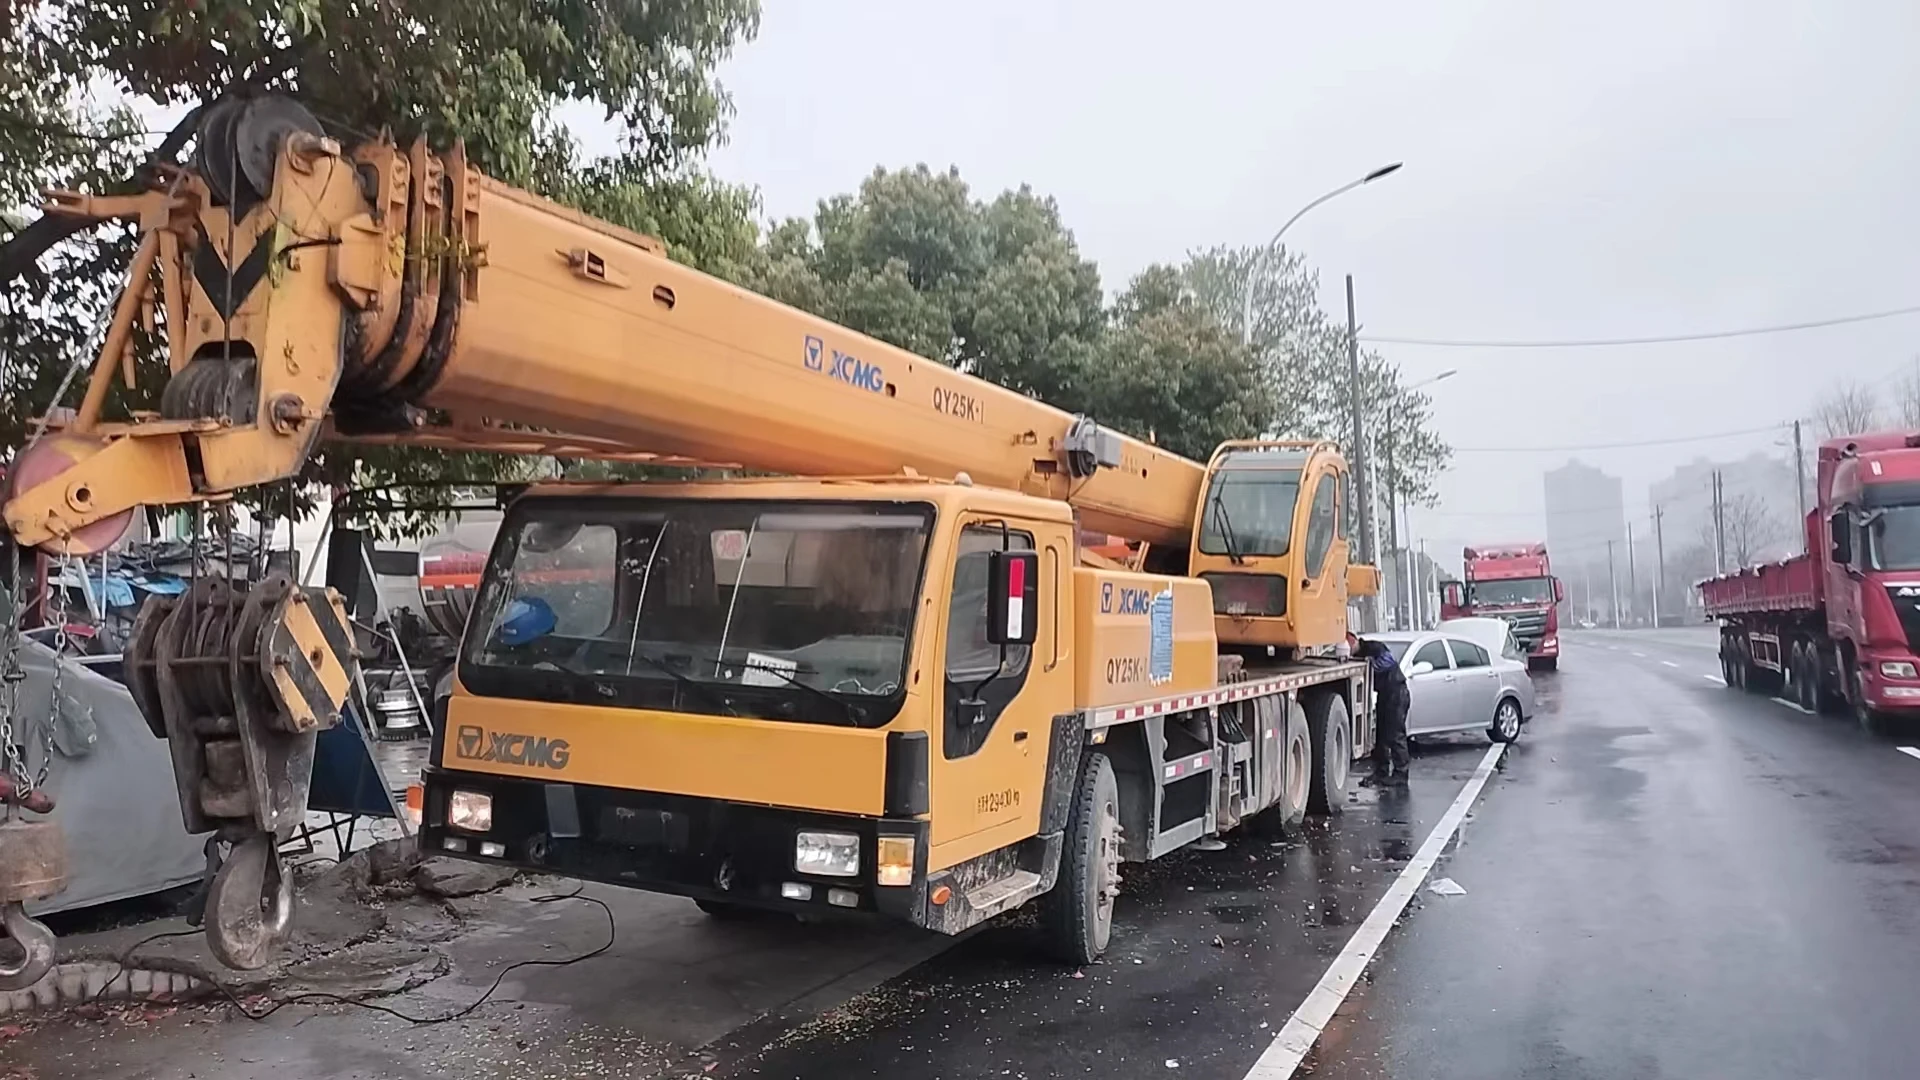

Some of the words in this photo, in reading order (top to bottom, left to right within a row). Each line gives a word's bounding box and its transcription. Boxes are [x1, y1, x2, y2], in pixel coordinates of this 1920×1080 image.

[828, 350, 883, 392] XCMG
[1119, 588, 1149, 615] XCMG
[480, 731, 570, 770] XCMG
